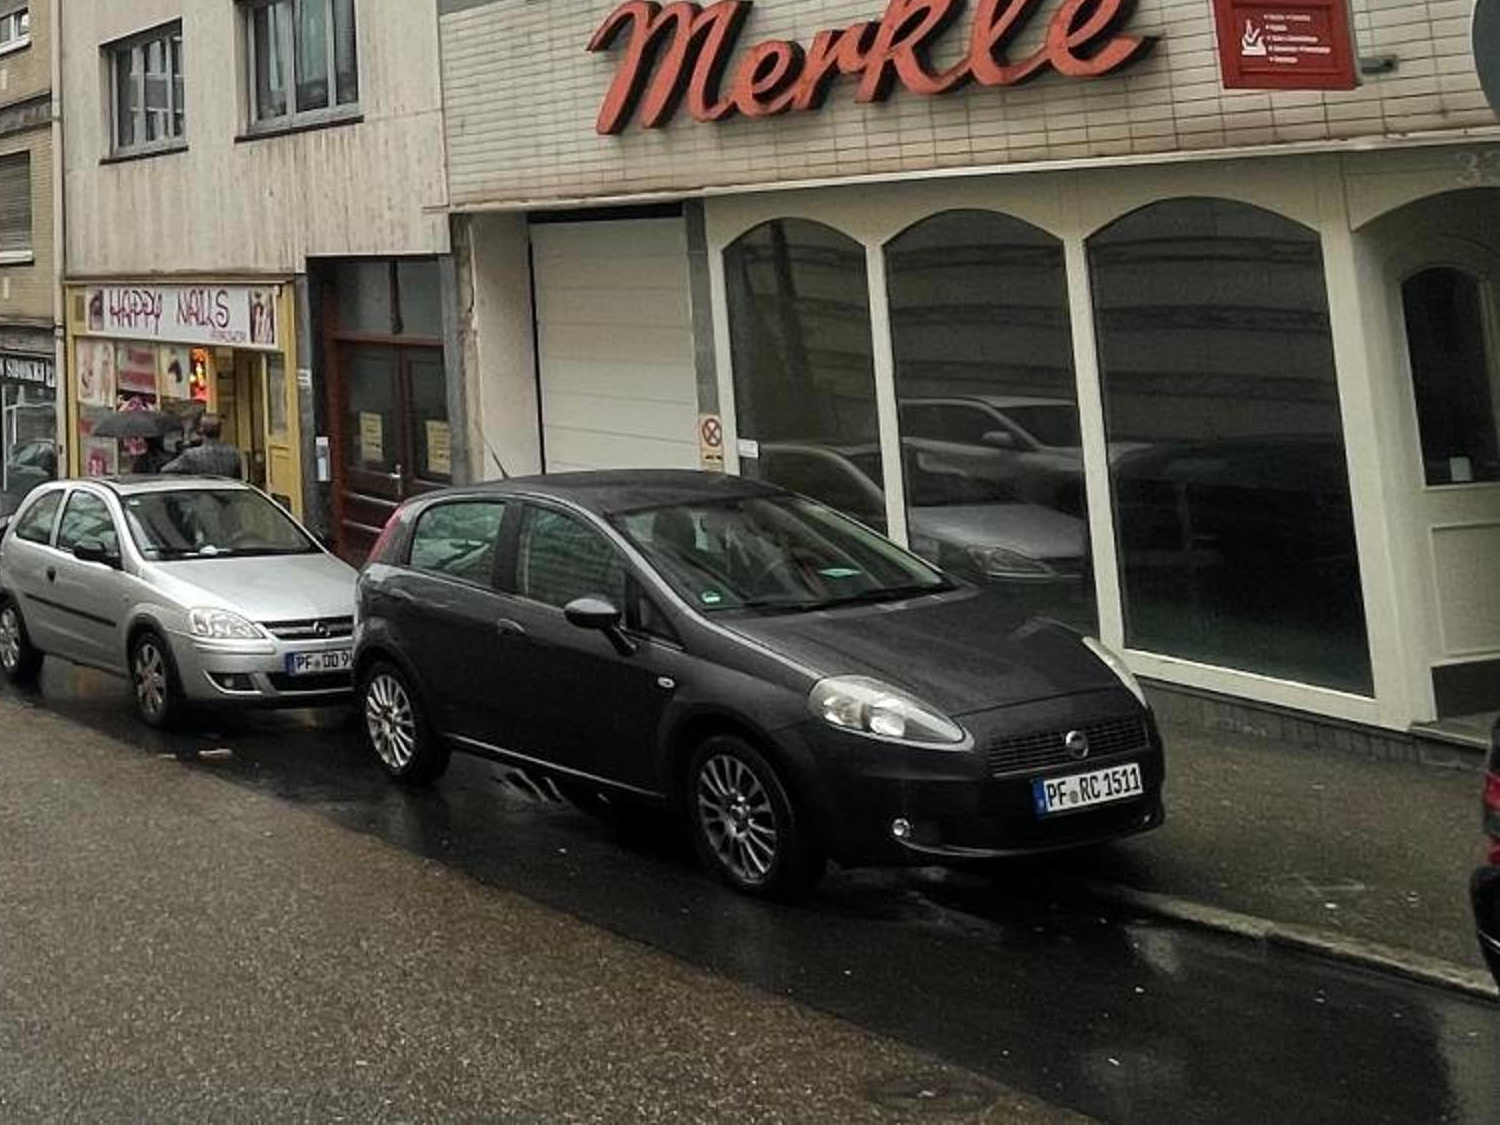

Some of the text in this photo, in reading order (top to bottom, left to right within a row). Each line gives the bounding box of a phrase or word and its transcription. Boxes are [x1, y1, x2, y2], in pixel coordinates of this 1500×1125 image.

[109, 288, 230, 336] HAPPY NAILS
[295, 654, 314, 670] PF
[1045, 767, 1141, 807] PF RC 1511
